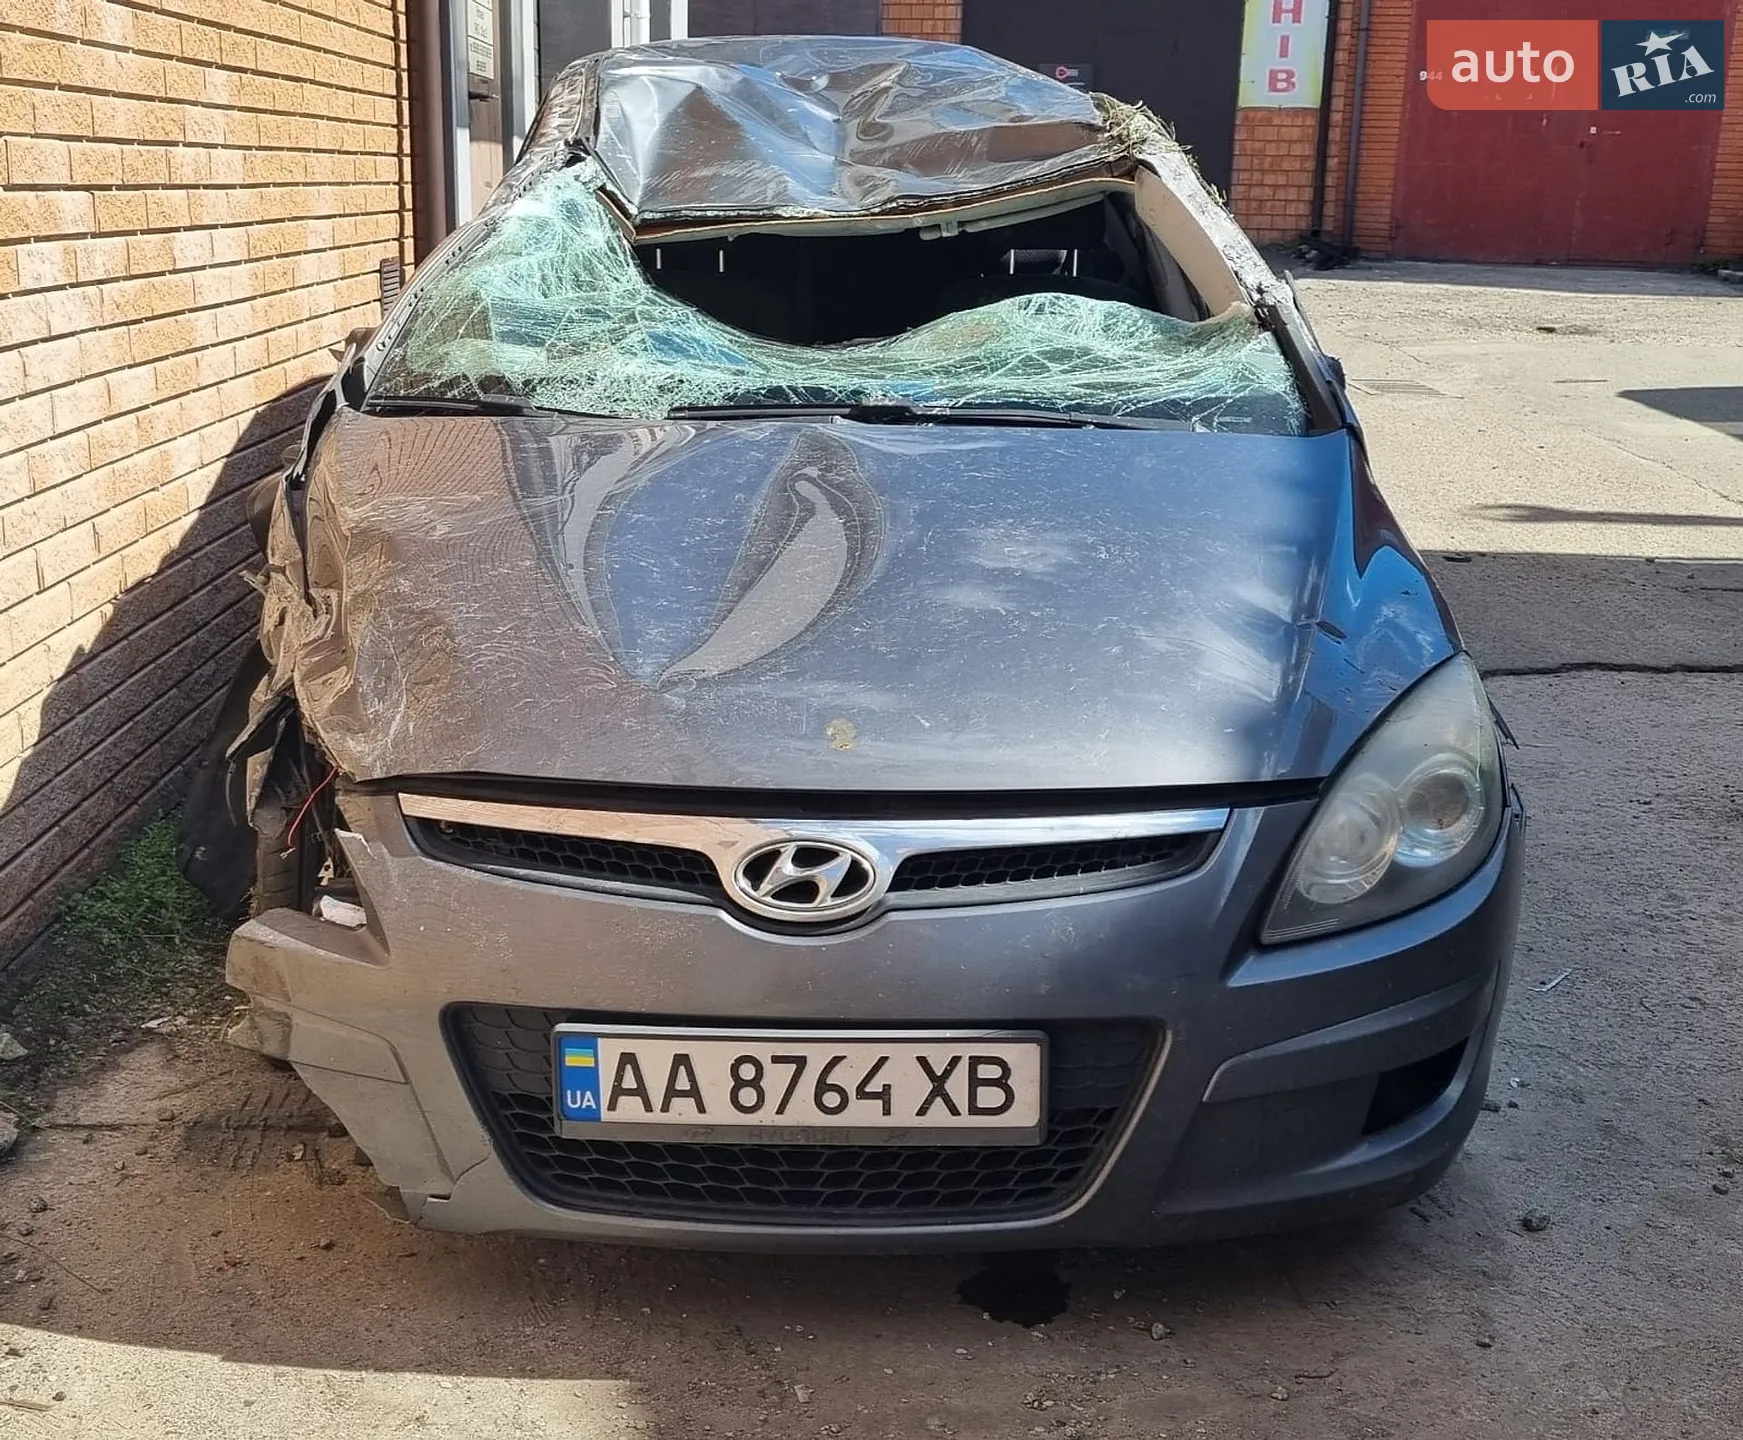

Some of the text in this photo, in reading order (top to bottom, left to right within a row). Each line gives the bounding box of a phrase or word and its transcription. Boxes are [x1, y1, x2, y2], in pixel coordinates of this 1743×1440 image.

[567, 1090, 597, 1109] UA
[607, 1052, 1016, 1117] AA 8764 XB
